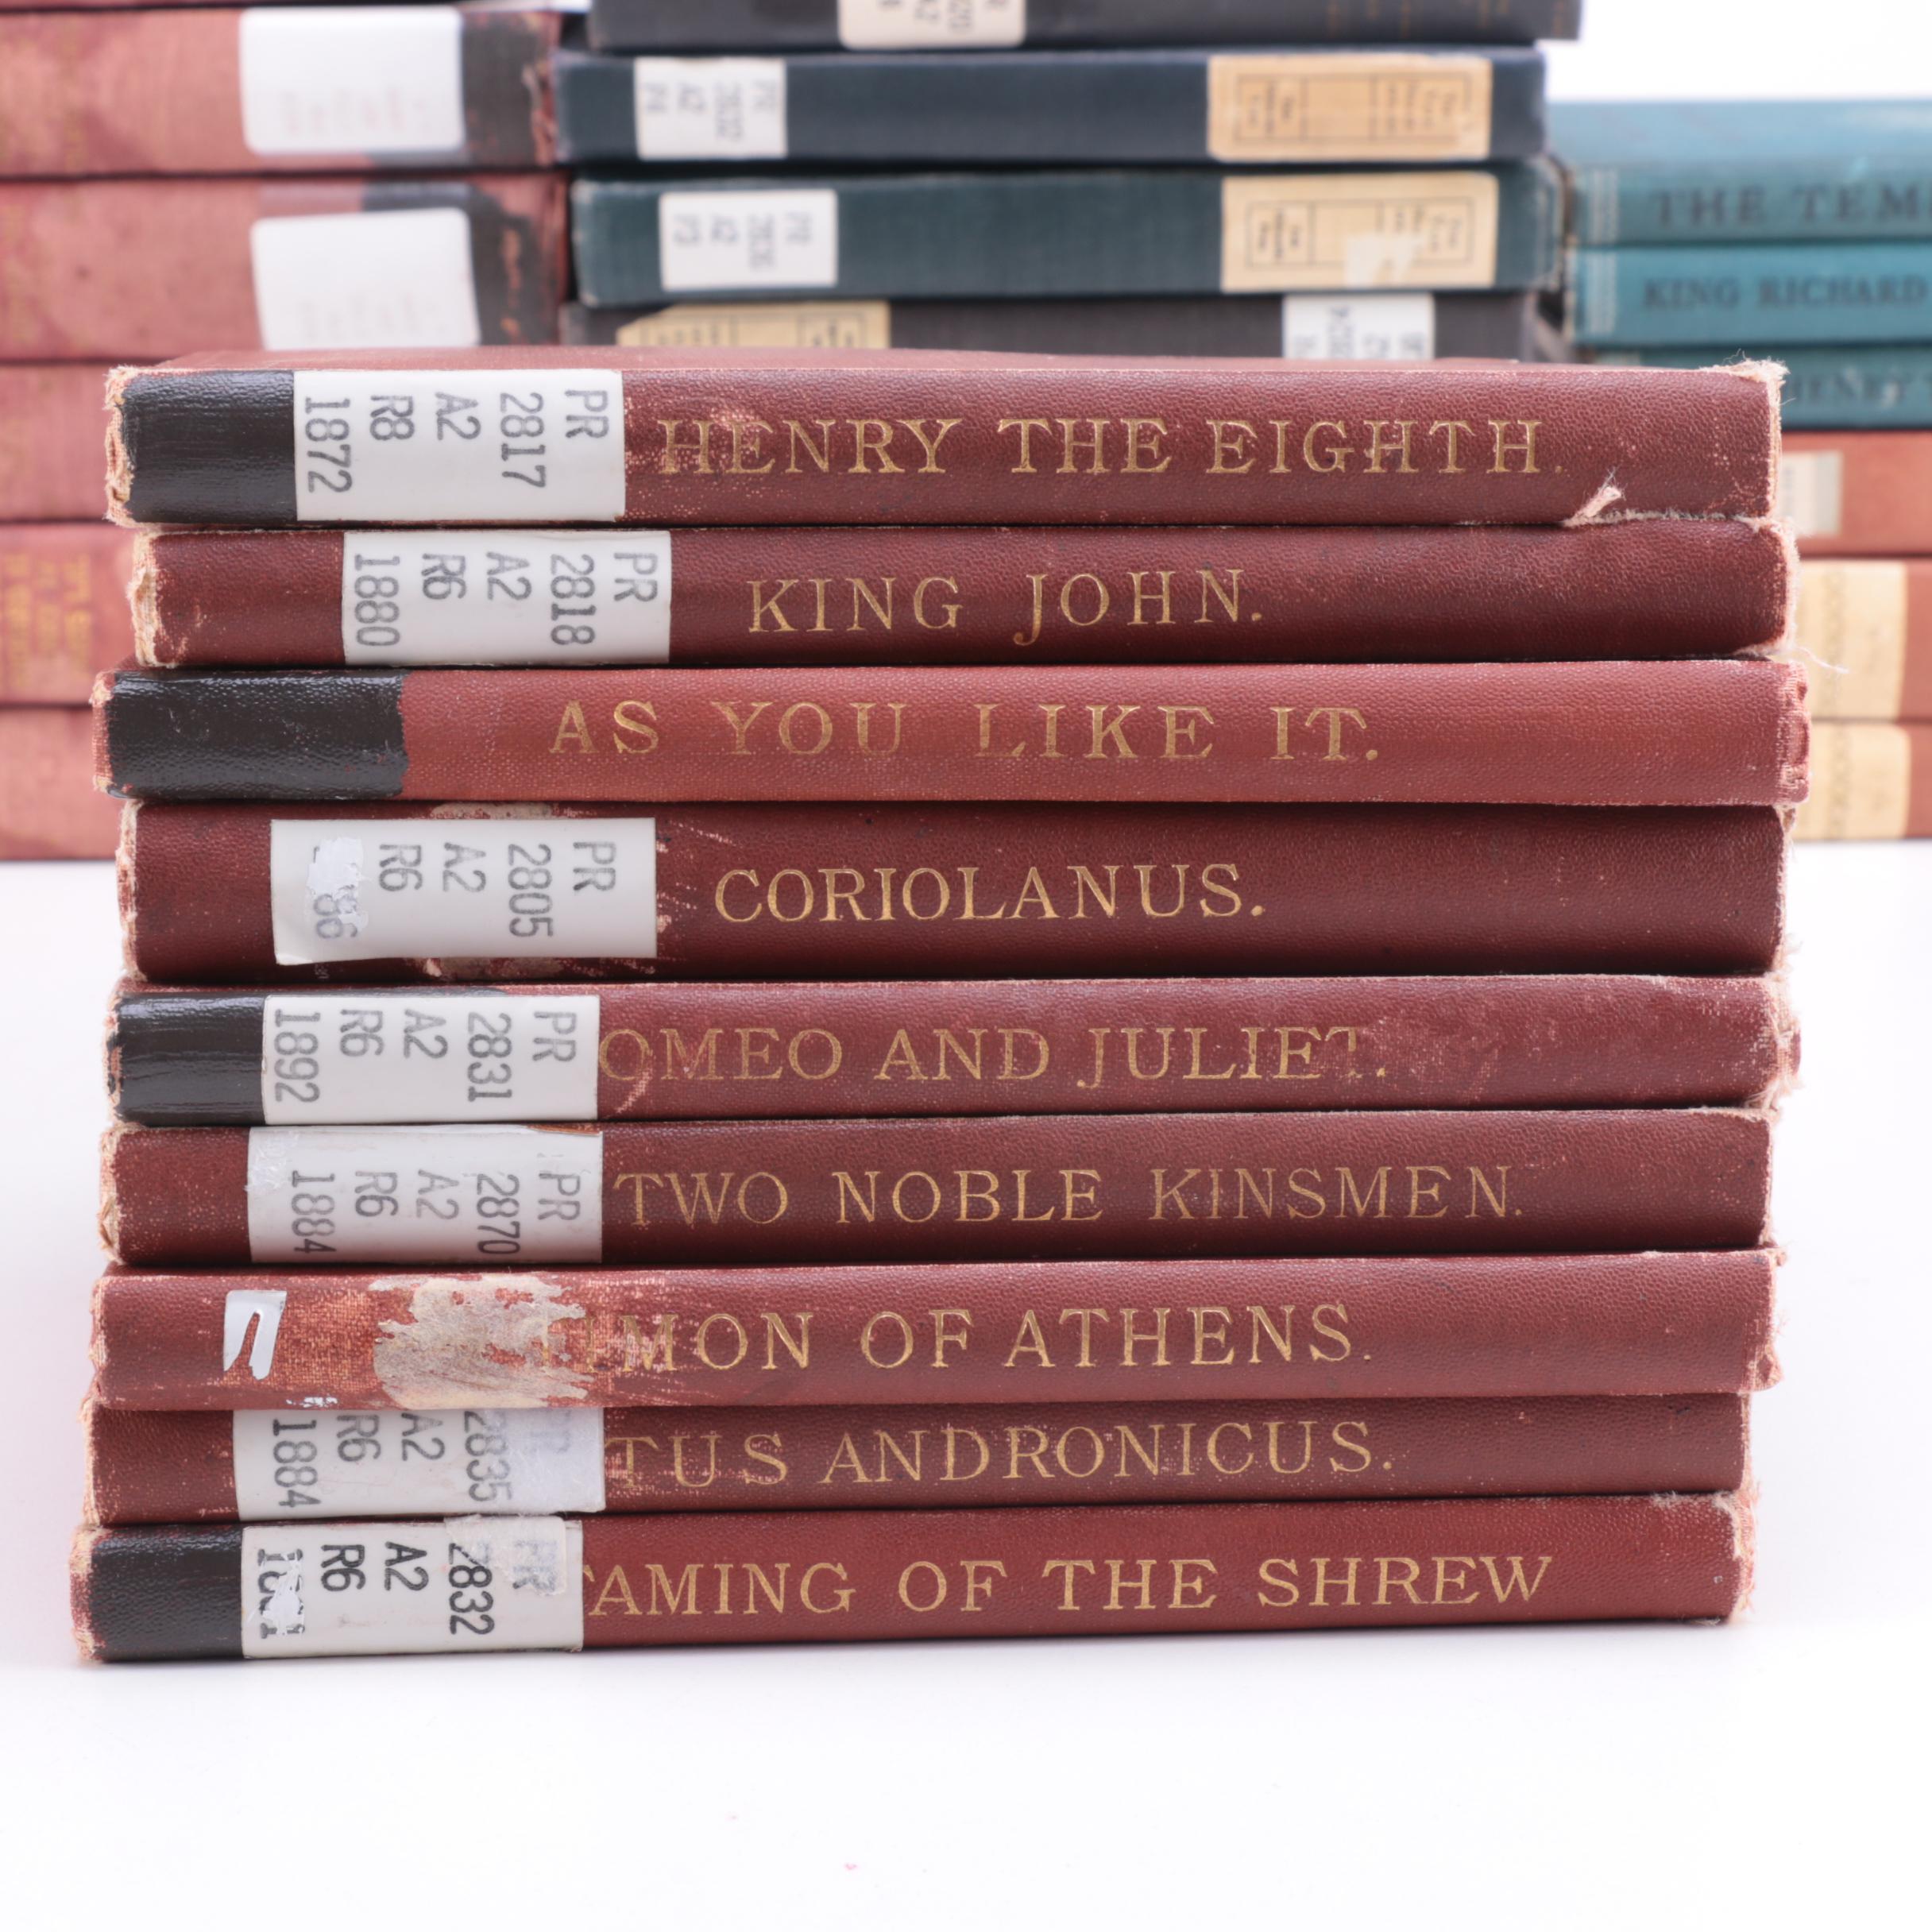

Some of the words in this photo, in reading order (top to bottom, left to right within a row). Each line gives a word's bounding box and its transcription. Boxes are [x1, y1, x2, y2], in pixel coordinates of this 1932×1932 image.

[1651, 185, 1765, 227] THE
[1792, 183, 1932, 223] TEM
[1643, 278, 1740, 309] KING
[1758, 275, 1929, 308] RICHARD
[369, 395, 415, 441] R8
[435, 392, 481, 441] A2
[500, 392, 547, 488] 2817
[564, 390, 609, 439] PR
[304, 397, 353, 493] 1872
[656, 418, 963, 475] HENRY
[997, 417, 1173, 474] THE
[1205, 418, 1563, 475] EIGHTH.
[354, 554, 400, 647] 1880
[421, 554, 467, 601] R6
[486, 552, 532, 601] A2
[550, 554, 597, 646] 2818
[613, 553, 658, 602] PR
[747, 576, 964, 633] KING
[1014, 569, 1262, 646] JOHN.
[549, 700, 659, 754] AS
[710, 701, 908, 755] YOU
[974, 704, 1215, 759] LIKE
[1270, 706, 1379, 761] IT.
[379, 844, 423, 892] R6
[442, 842, 486, 892] A2
[508, 844, 554, 937] 2805
[573, 842, 616, 892] PR
[716, 864, 1265, 922] CORIOLANUS.
[274, 1009, 321, 1103] 1892
[339, 1009, 384, 1057] R6
[404, 1009, 448, 1059] A2
[467, 1012, 512, 1102] 2831
[532, 1011, 577, 1062] PR
[874, 1027, 1051, 1080] AND
[1077, 1026, 1387, 1089] JULIET.
[290, 1170, 337, 1254] 1884
[354, 1171, 399, 1217] R6
[416, 1169, 459, 1219] A2
[476, 1173, 521, 1256] 2870
[536, 1170, 582, 1222] PR
[612, 1171, 789, 1226] TWO
[832, 1169, 1103, 1224] NOBLE
[1148, 1166, 1523, 1222] KINSMEN.
[860, 1308, 976, 1369] OF
[1003, 1303, 1372, 1369] ATHENS.
[272, 1418, 321, 1508] 1884
[336, 1414, 381, 1463] R6
[400, 1412, 445, 1462] A2
[463, 1411, 512, 1501] 2835
[816, 1420, 1393, 1485] ANDRONICUS.
[319, 1544, 367, 1592] R6
[384, 1541, 429, 1591] A2
[447, 1542, 496, 1635] 2832
[583, 1562, 856, 1616] AMING
[898, 1560, 1009, 1613] OF
[1042, 1558, 1218, 1611] THE
[1258, 1555, 1553, 1608] SHREW
